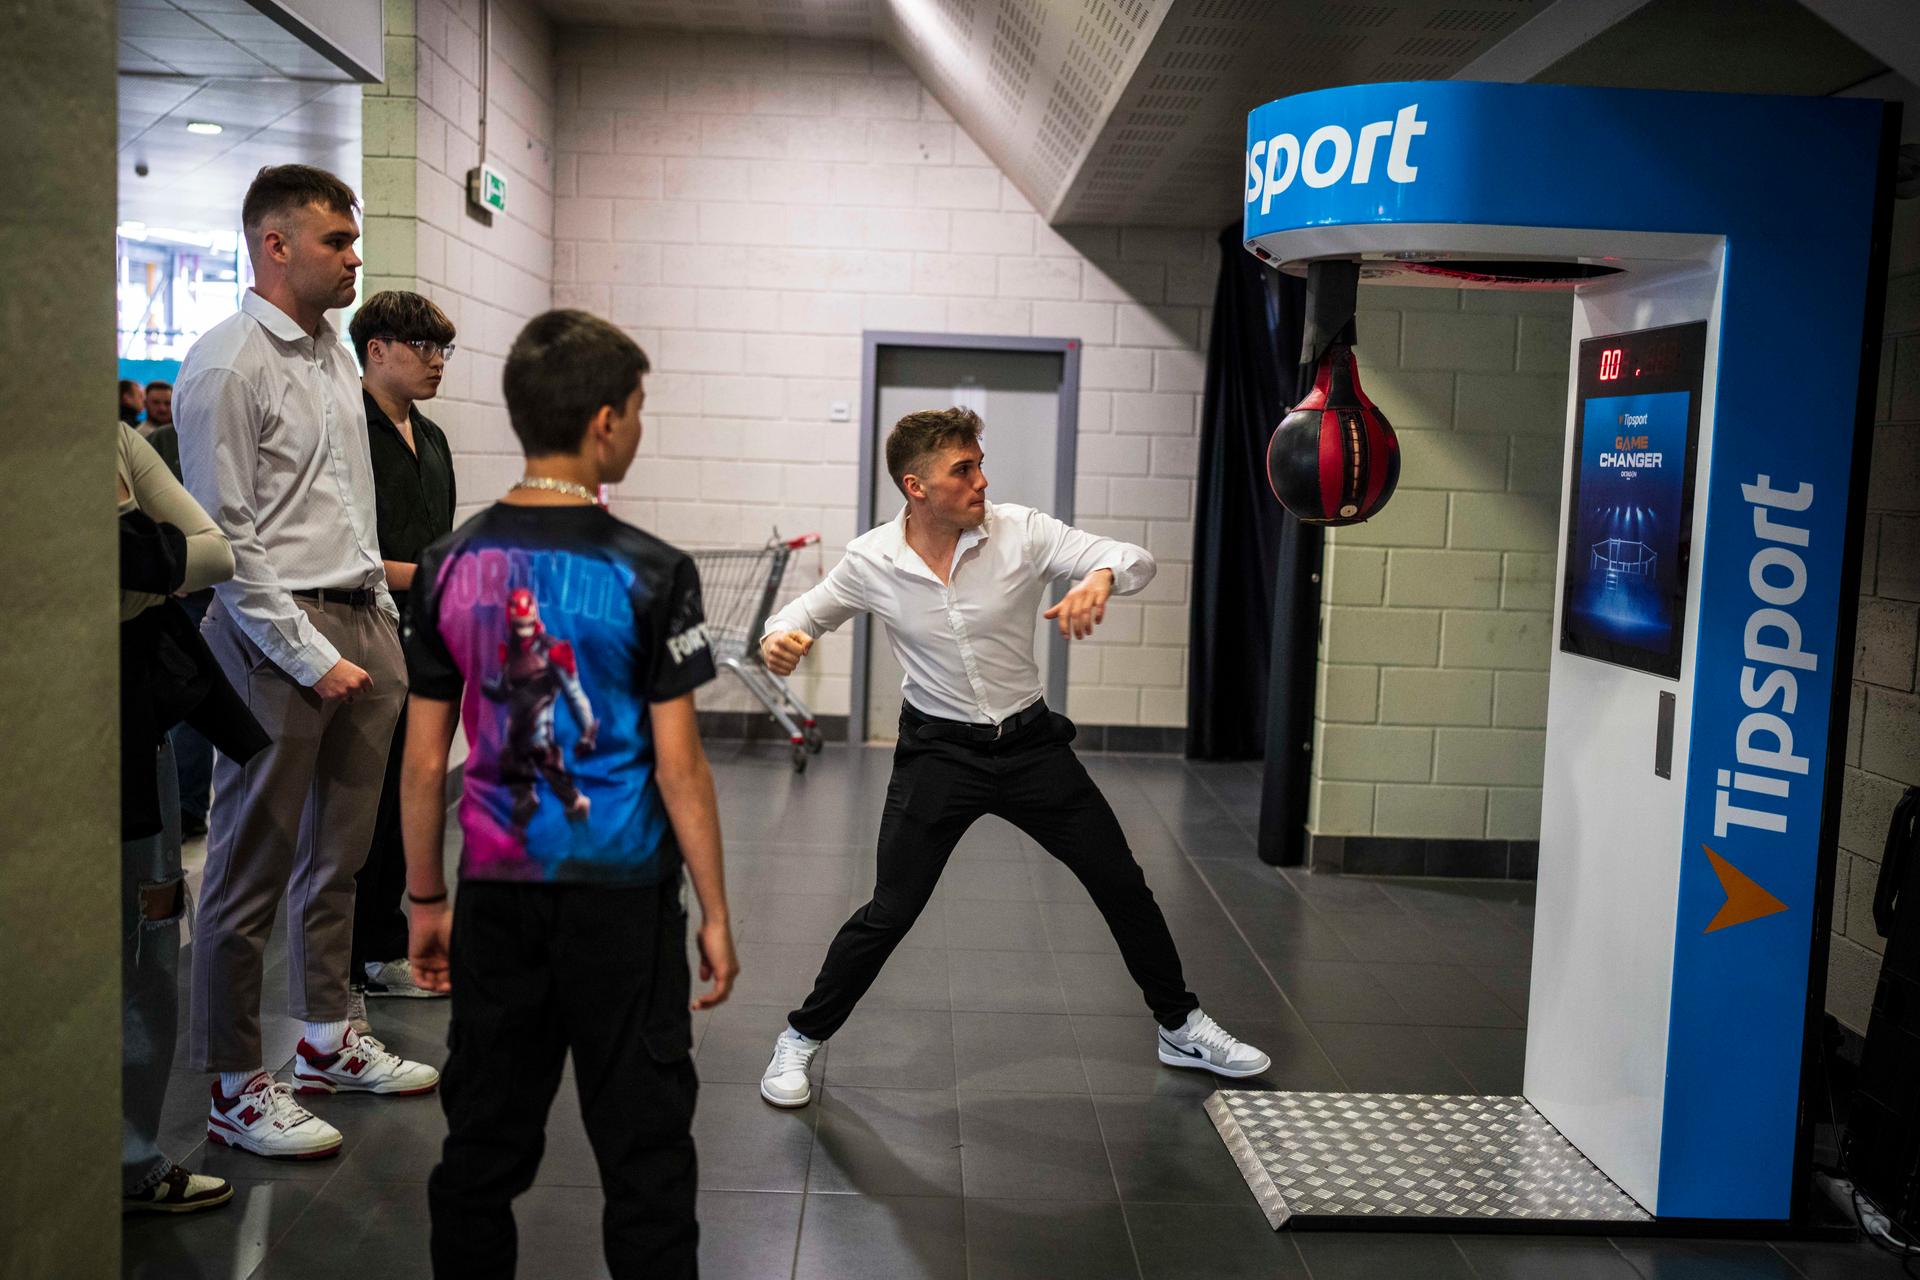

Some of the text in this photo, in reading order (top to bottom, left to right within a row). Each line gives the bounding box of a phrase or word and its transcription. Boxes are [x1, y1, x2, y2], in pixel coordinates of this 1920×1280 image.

[1623, 413, 1648, 427] Tipsport
[1615, 436, 1649, 451] GAME
[1599, 452, 1662, 468] CHANGER
[1713, 473, 1818, 838] Tipsport
